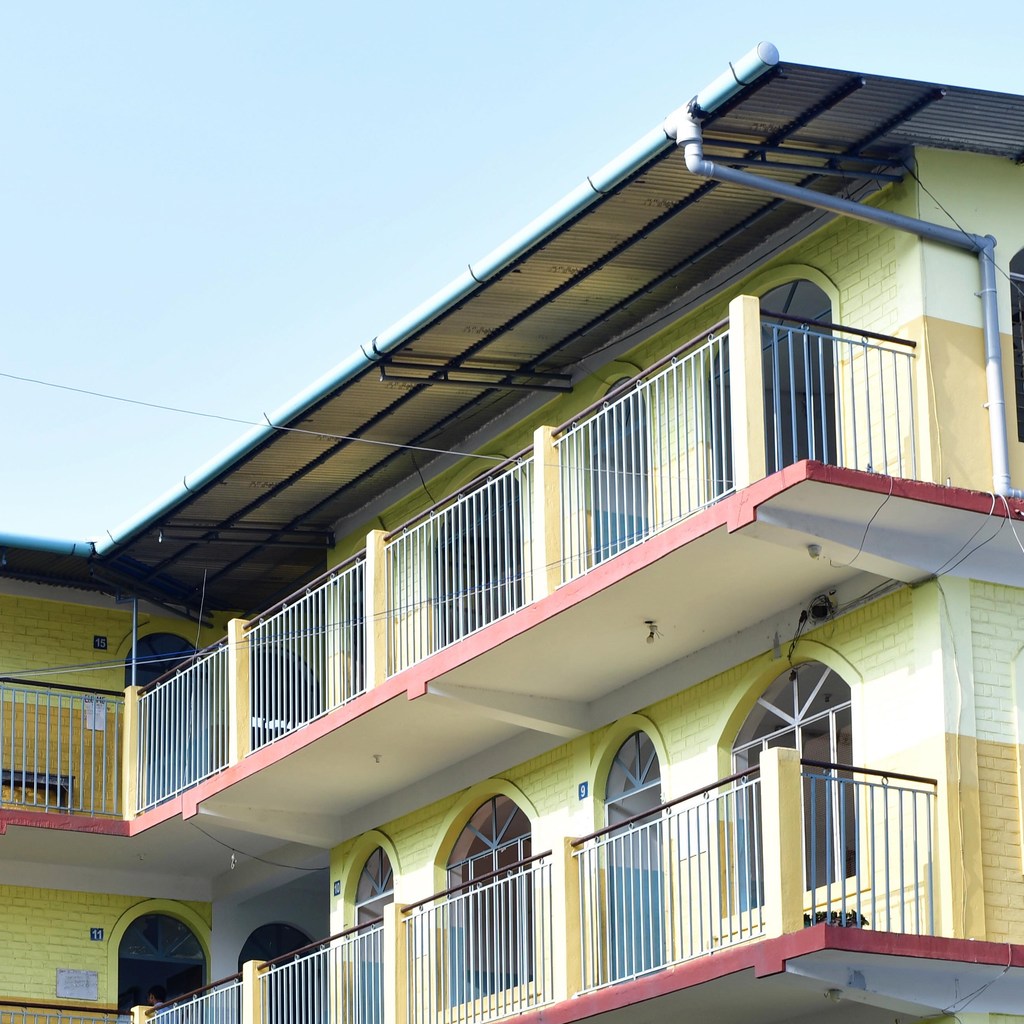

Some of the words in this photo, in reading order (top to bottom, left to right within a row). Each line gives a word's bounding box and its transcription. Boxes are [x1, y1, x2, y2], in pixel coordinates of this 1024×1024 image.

[95, 638, 106, 648] 15
[580, 785, 586, 797] 9
[91, 929, 103, 940] 11
